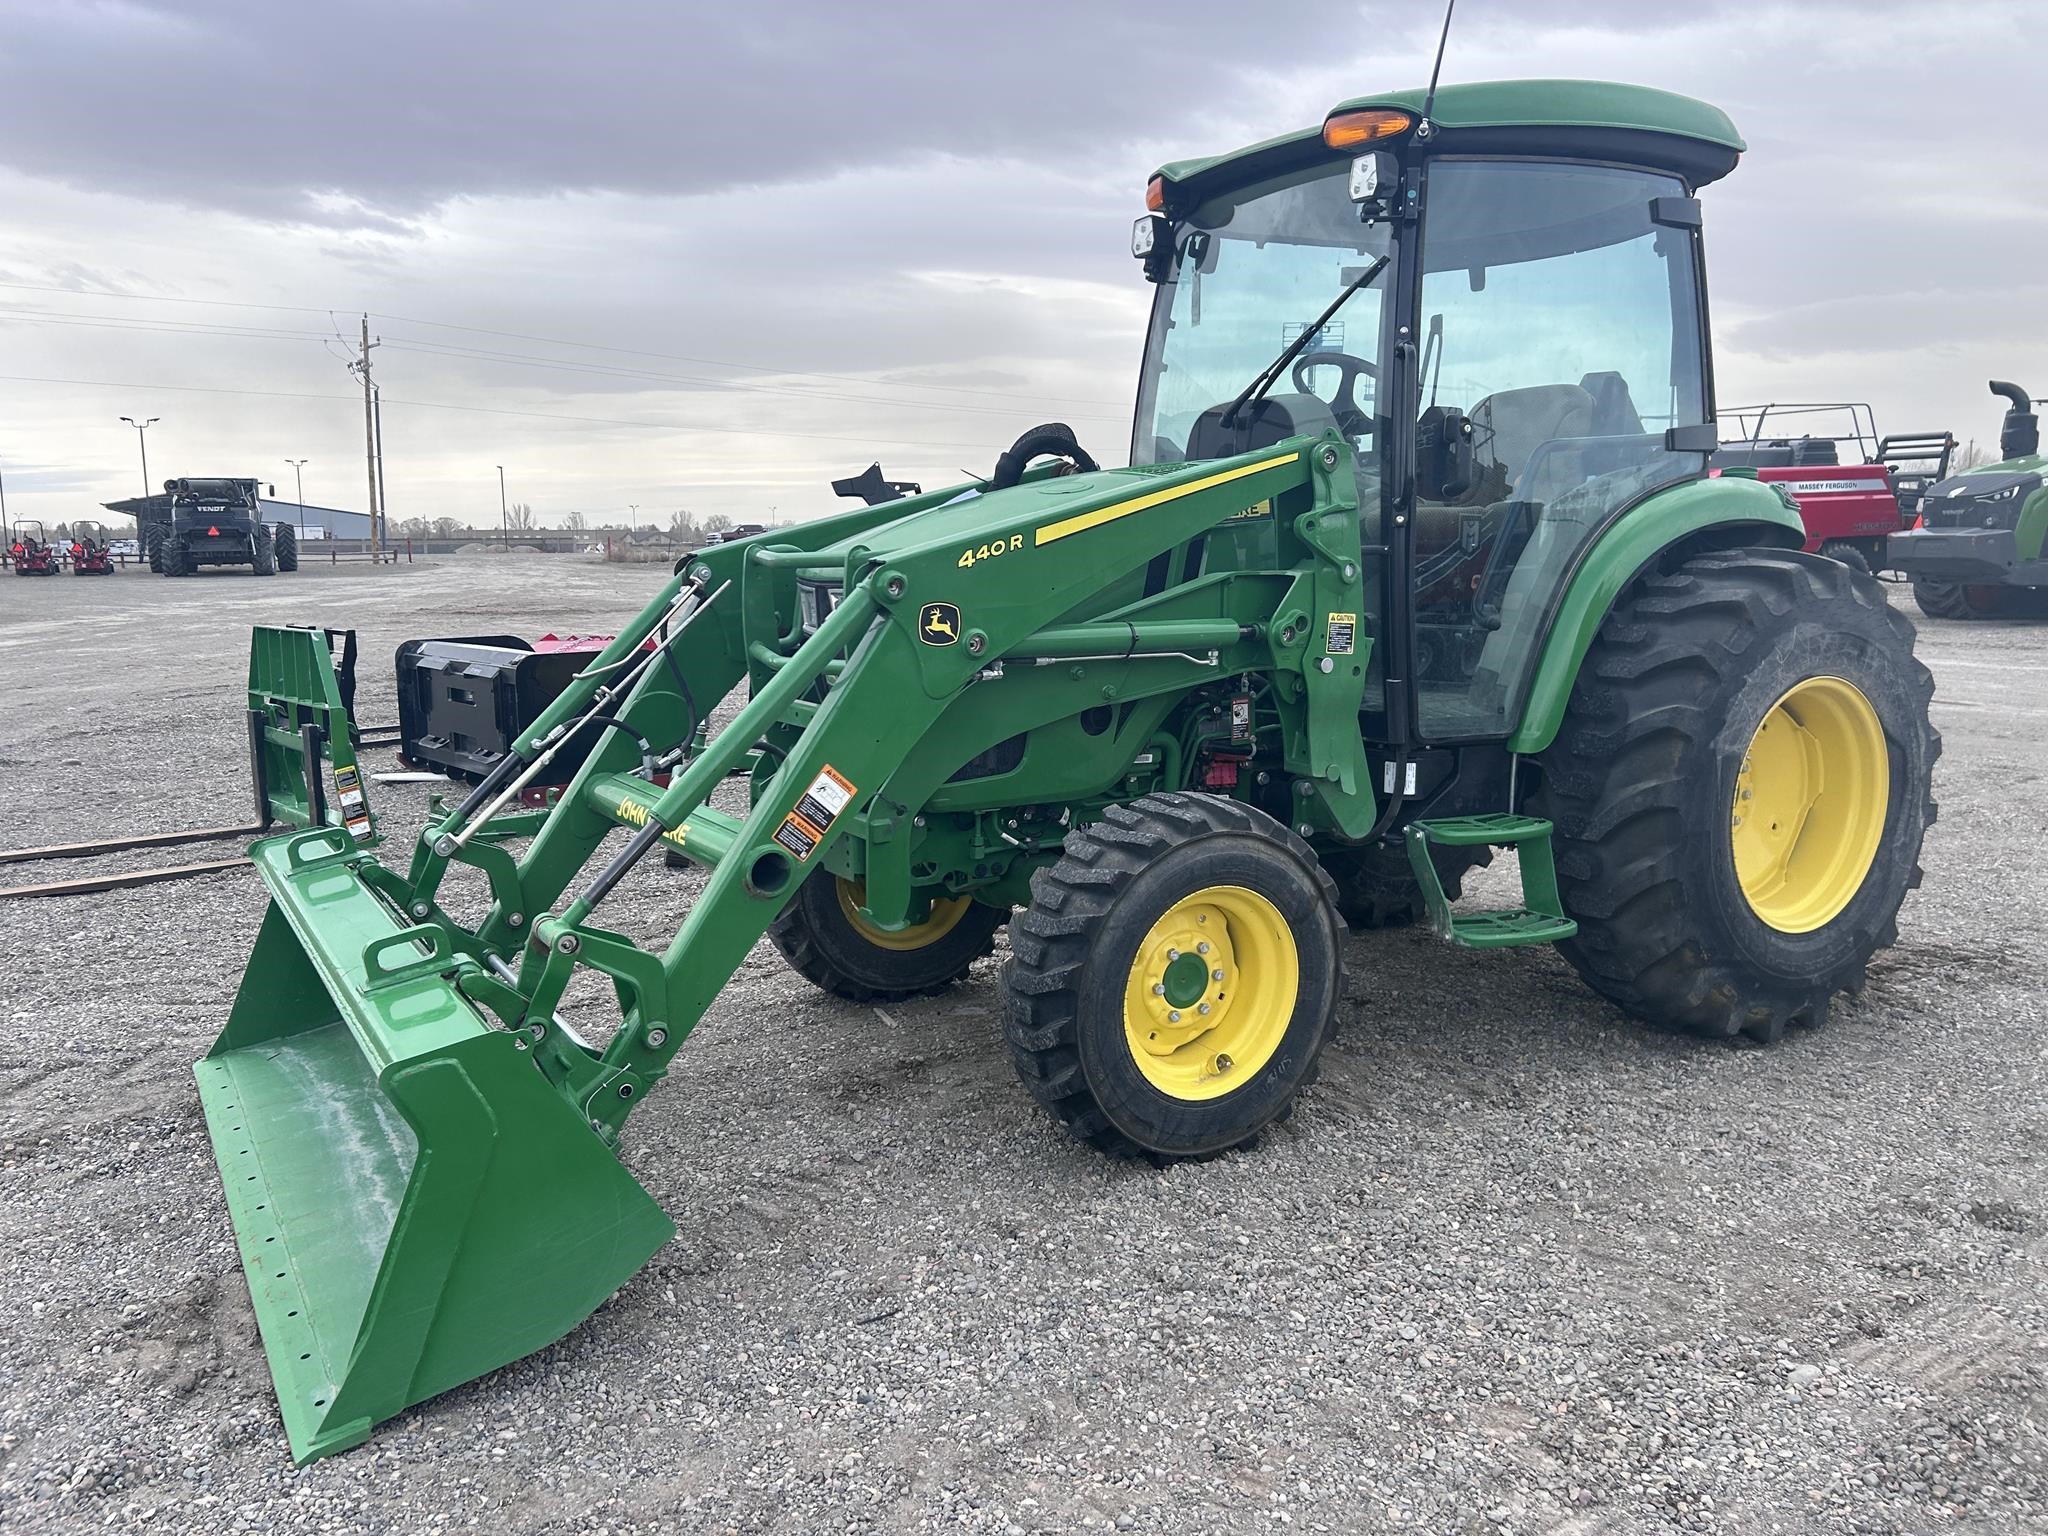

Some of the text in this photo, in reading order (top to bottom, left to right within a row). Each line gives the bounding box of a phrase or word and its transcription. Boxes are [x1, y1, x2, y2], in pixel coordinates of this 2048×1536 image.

[957, 534, 1023, 568] 440 R
[616, 796, 650, 827] JOHN
